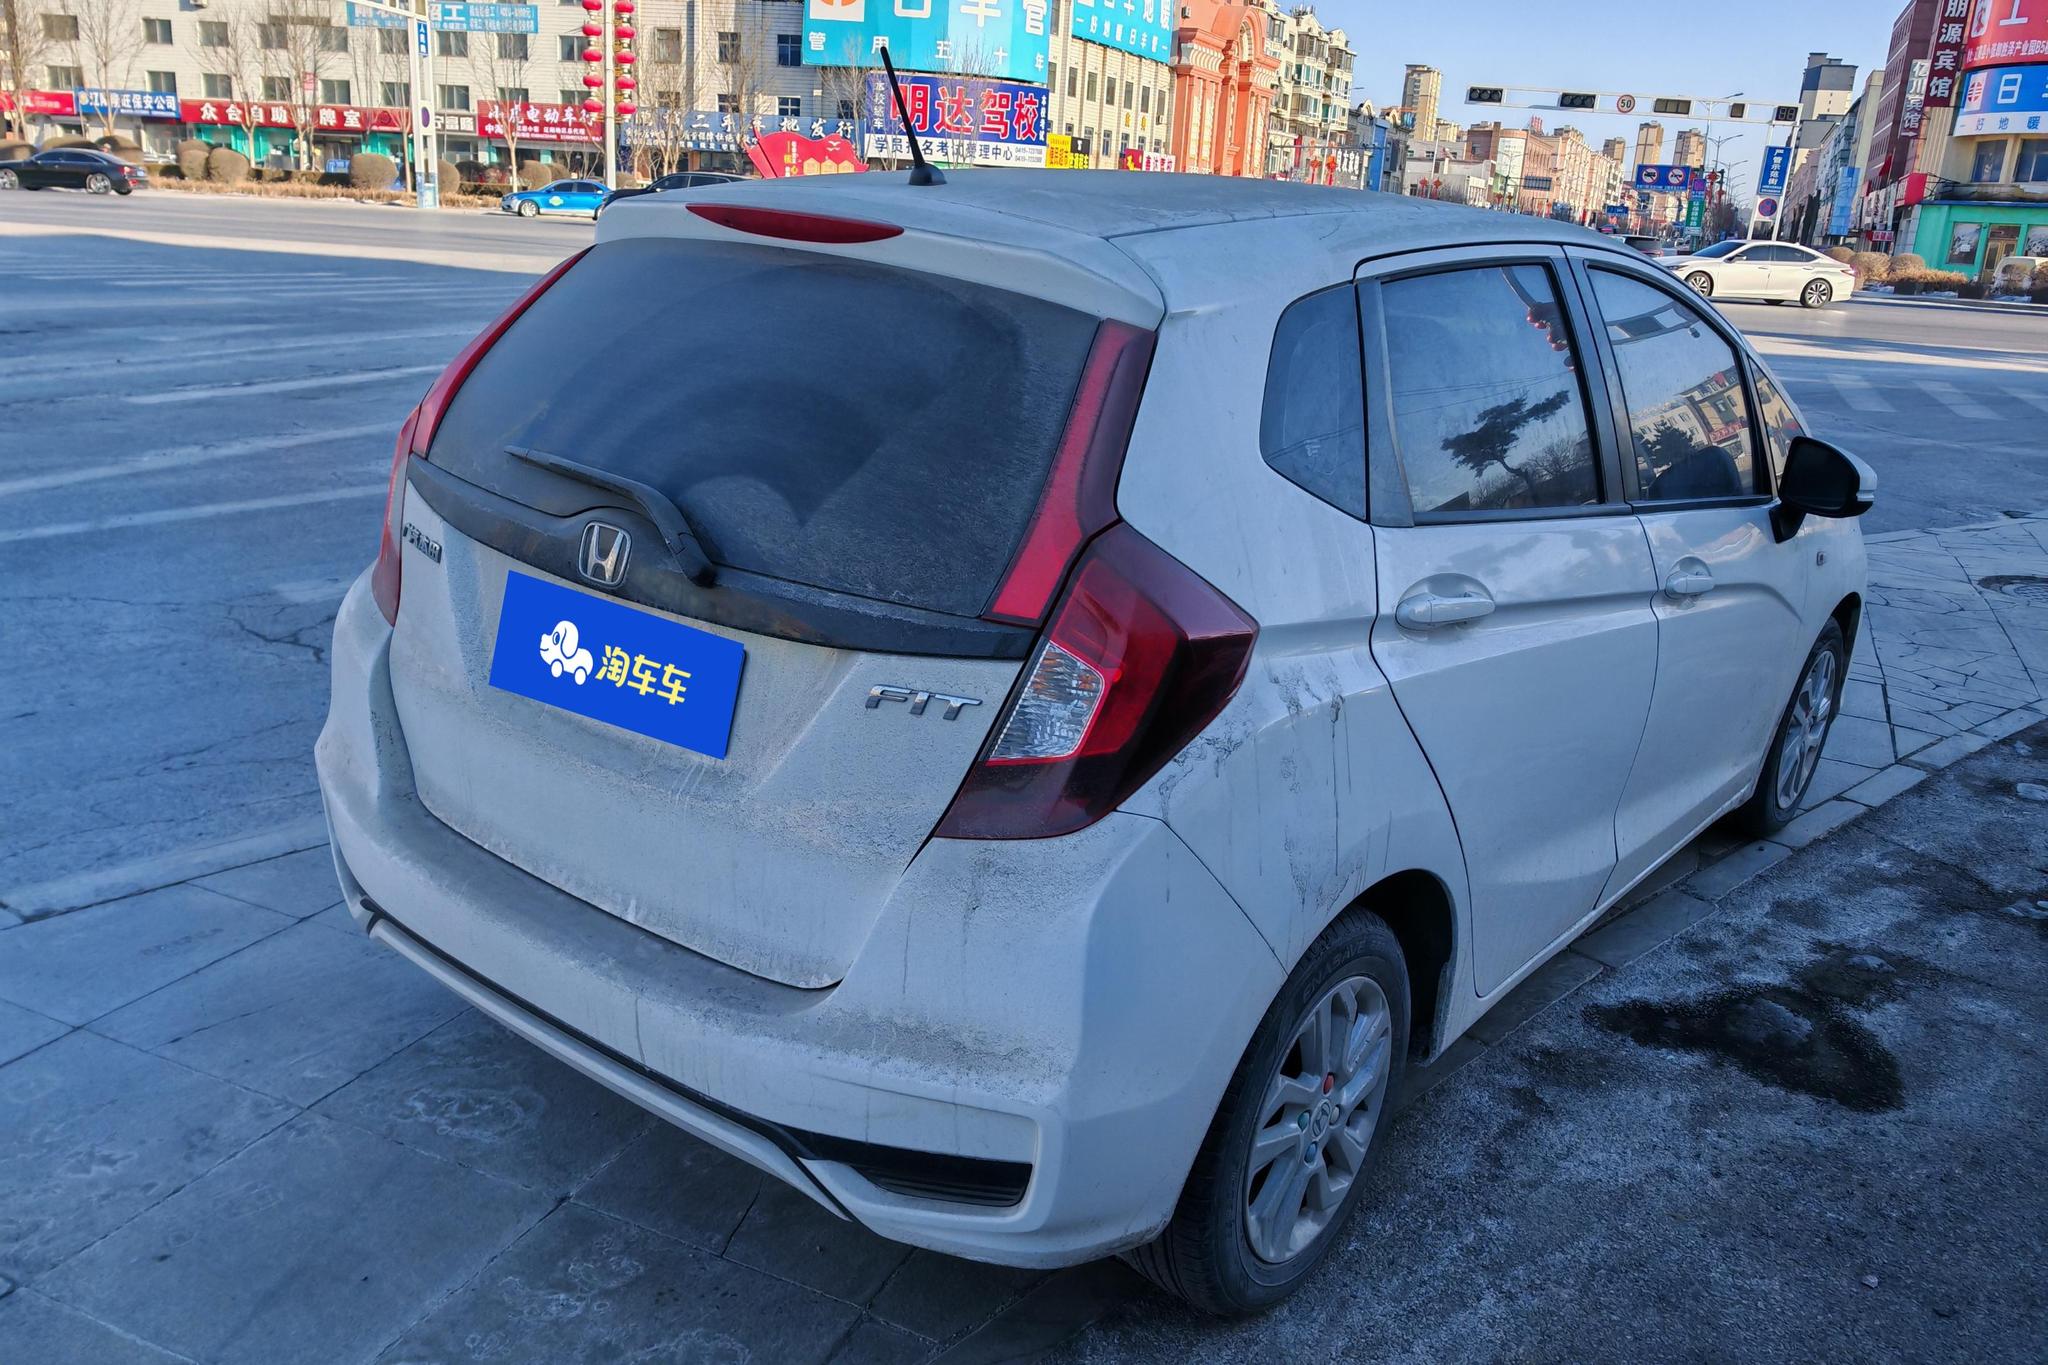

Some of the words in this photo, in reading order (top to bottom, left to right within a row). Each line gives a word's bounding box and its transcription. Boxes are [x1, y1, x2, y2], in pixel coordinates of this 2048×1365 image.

[889, 83, 1040, 142] 明达驾校
[1619, 98, 1633, 110] 50
[865, 684, 983, 721] FIT
